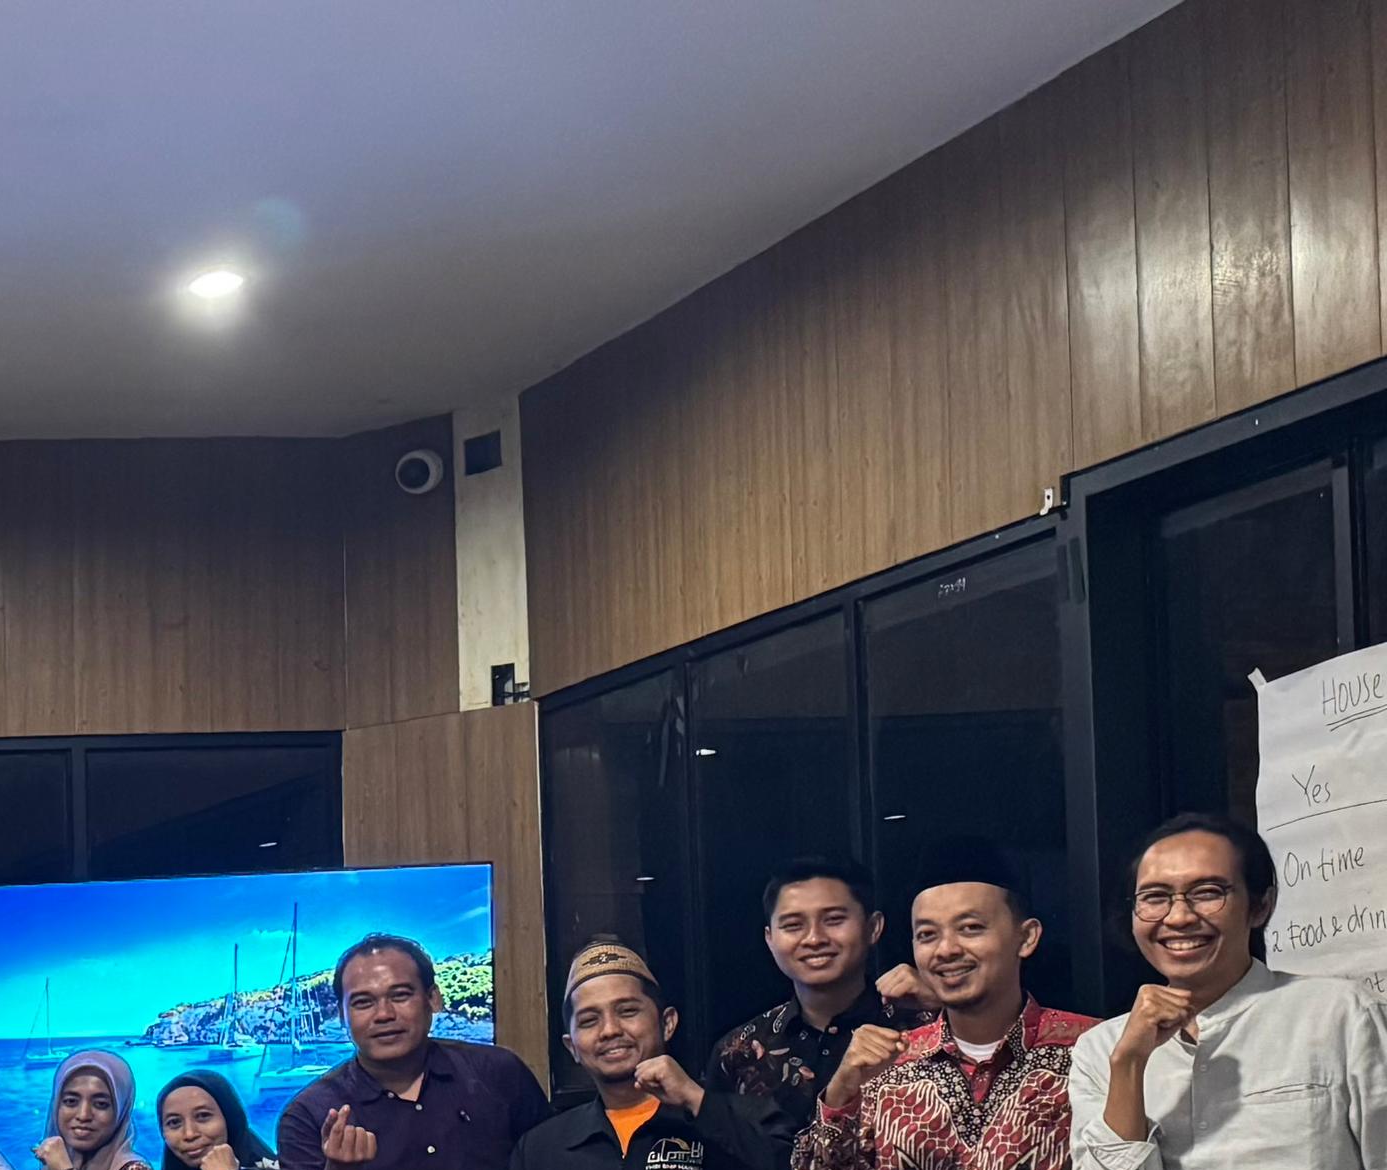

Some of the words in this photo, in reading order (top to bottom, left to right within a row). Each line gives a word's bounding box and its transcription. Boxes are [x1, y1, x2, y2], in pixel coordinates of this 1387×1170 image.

[1291, 764, 1332, 807] Yes
[1283, 851, 1312, 888] On
[1317, 844, 1365, 884] time
